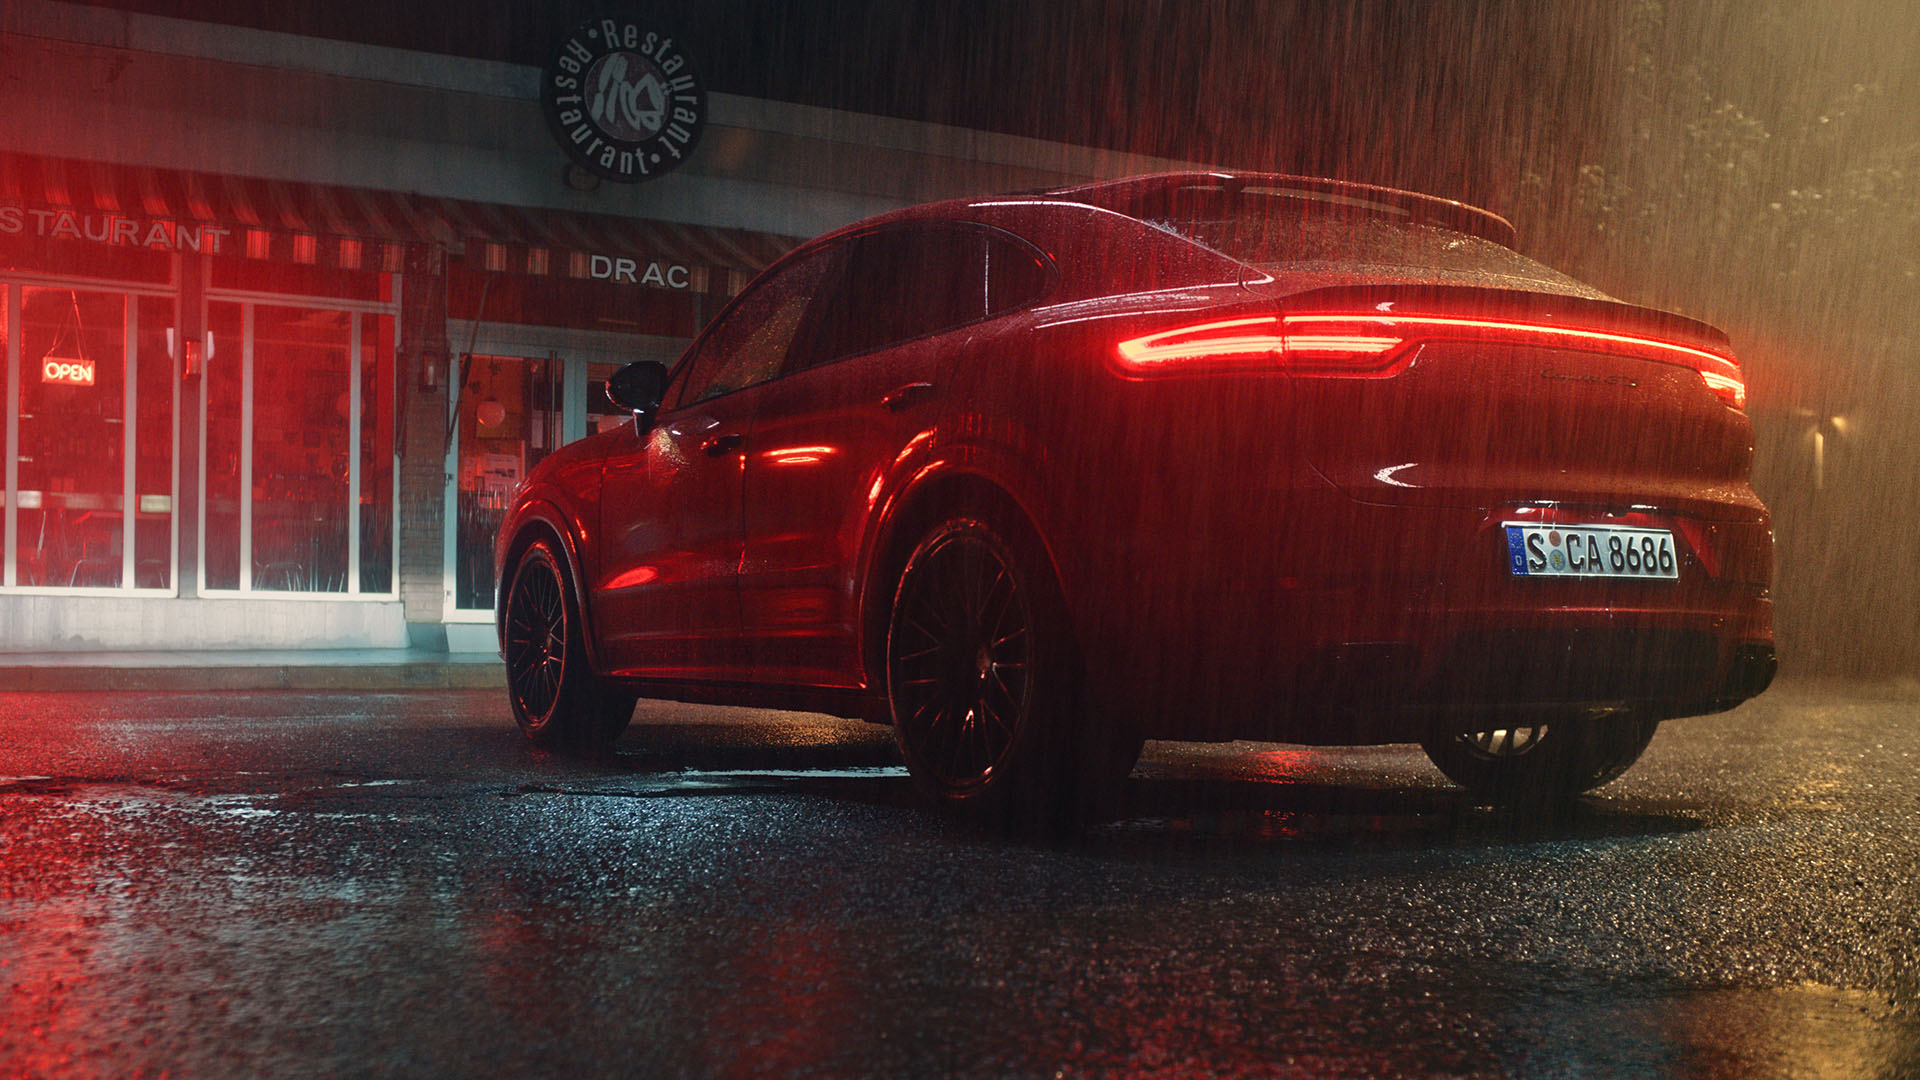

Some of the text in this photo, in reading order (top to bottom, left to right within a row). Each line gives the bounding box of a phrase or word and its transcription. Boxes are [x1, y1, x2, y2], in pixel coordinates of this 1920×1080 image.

[555, 38, 649, 175] Restaurant
[601, 19, 698, 159] Restaurant
[0, 206, 231, 253] STAURANT
[590, 254, 689, 289] DRAC
[44, 361, 93, 382] OPEN
[1527, 532, 1547, 570] S
